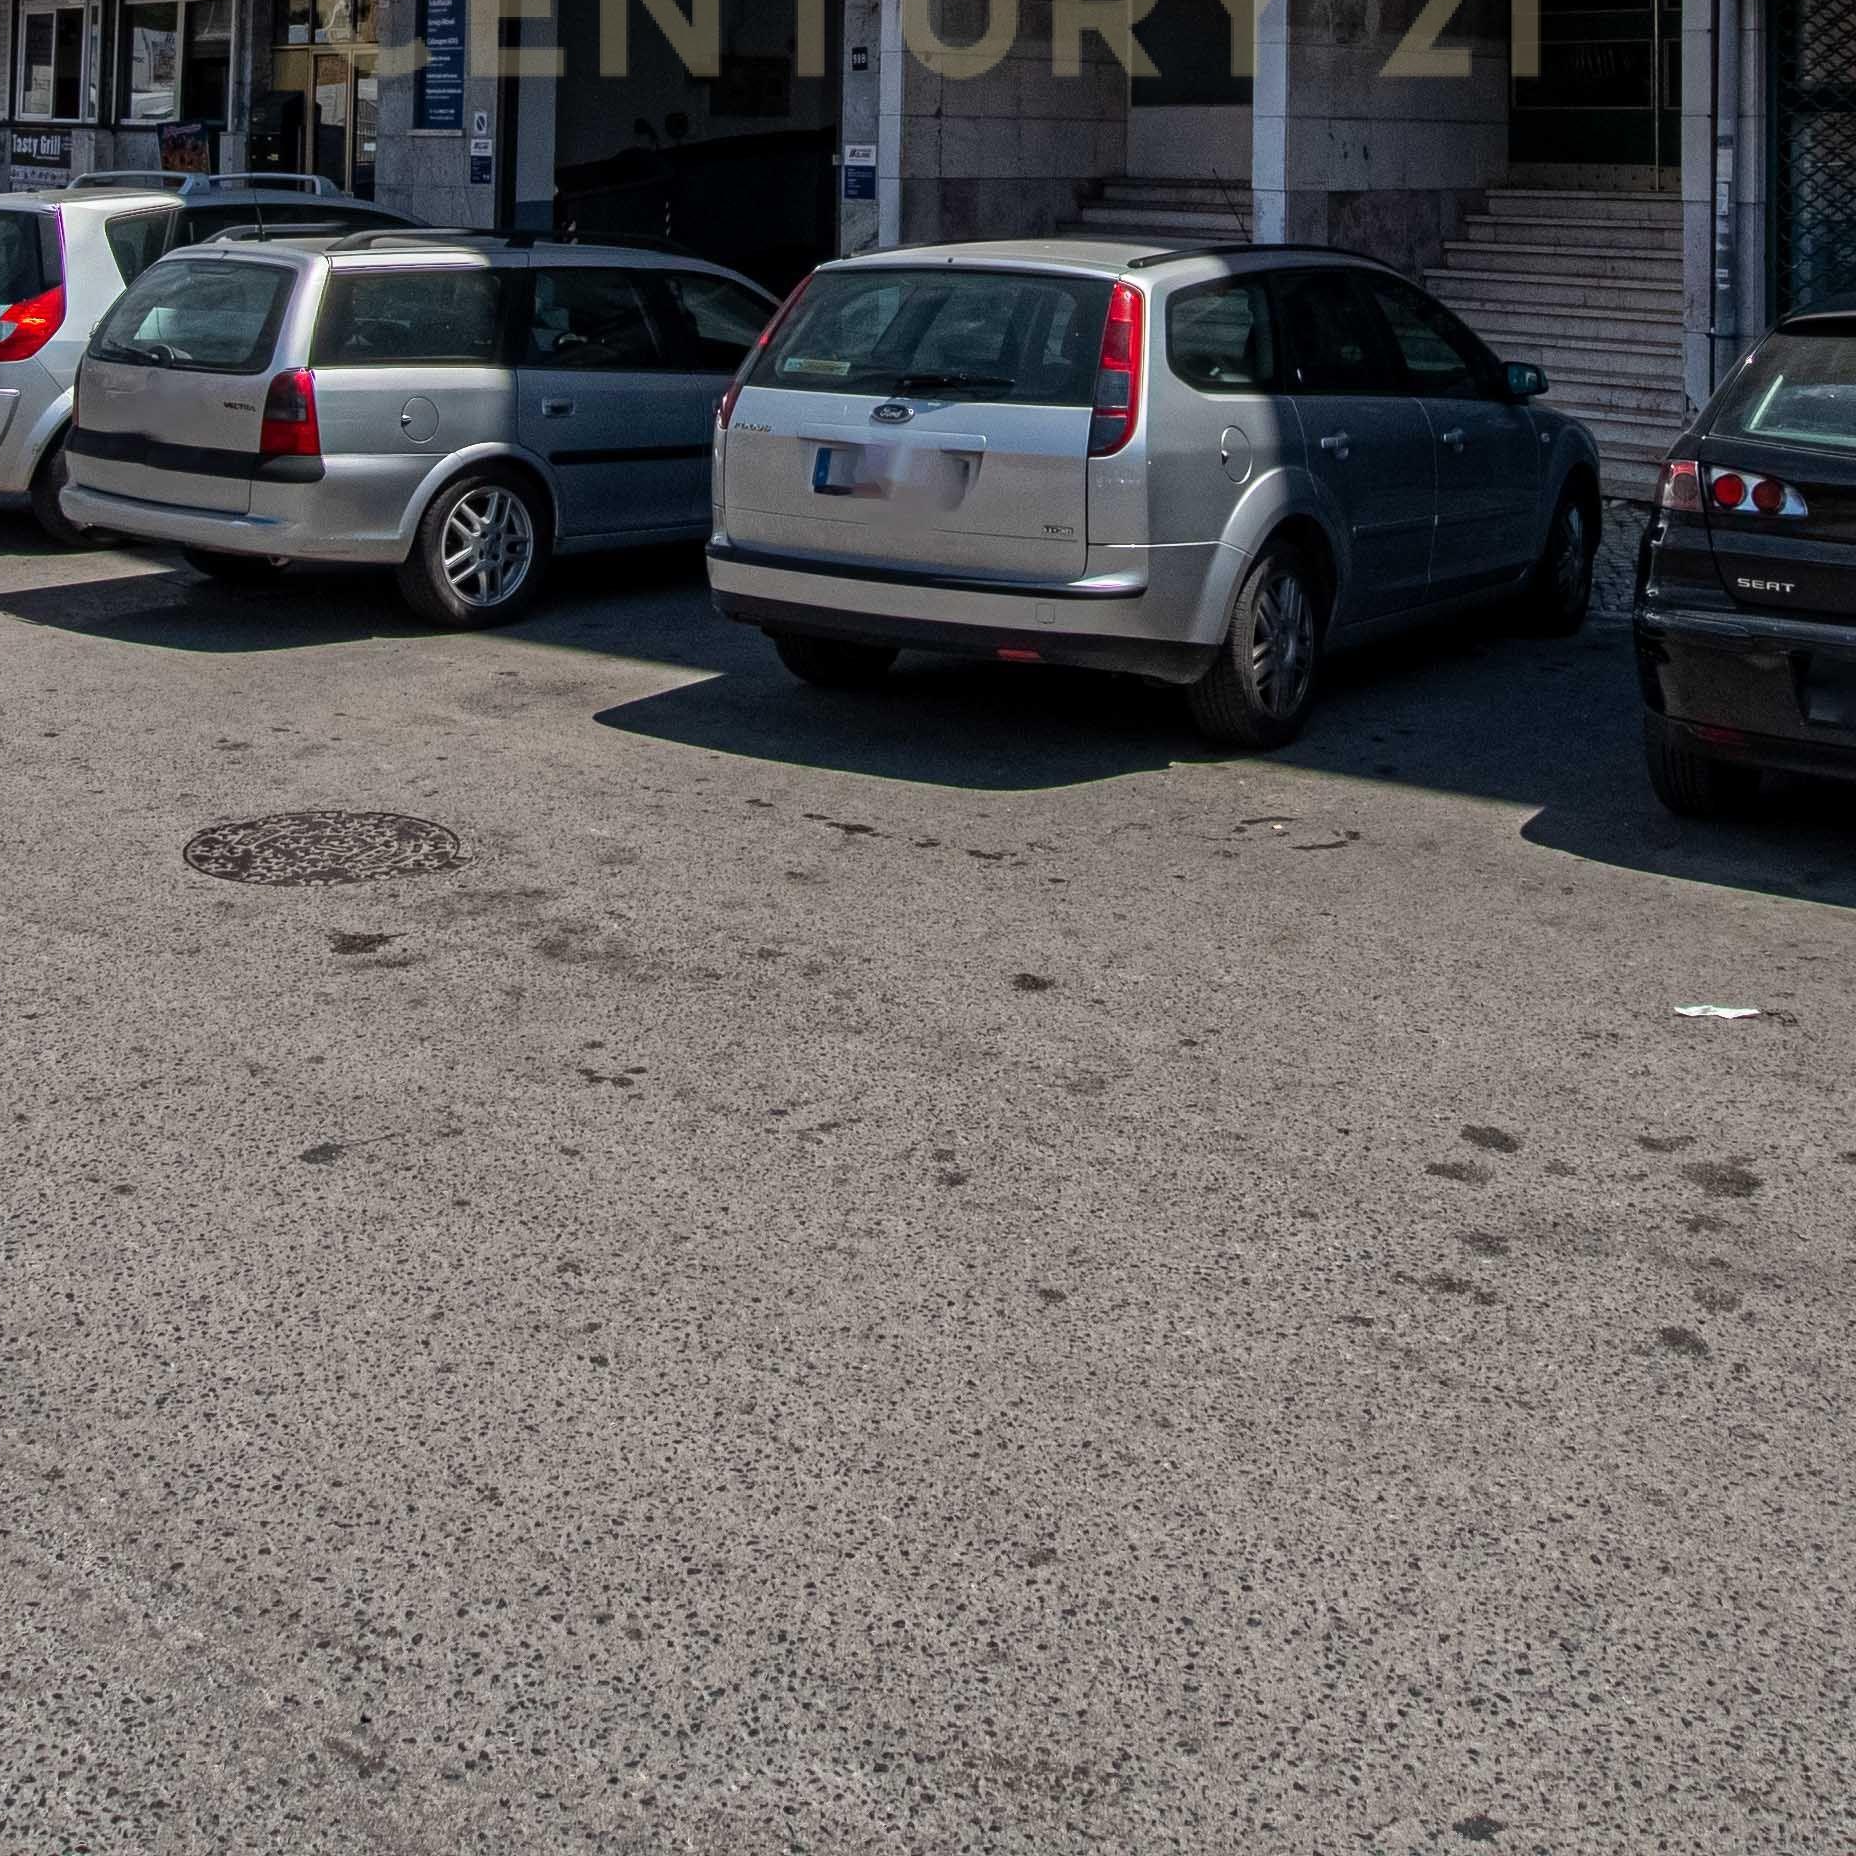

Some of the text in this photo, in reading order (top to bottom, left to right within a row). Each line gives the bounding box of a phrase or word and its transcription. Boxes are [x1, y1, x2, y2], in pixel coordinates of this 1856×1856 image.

[13, 134, 37, 158] Tasty
[40, 135, 61, 156] Grill
[1737, 577, 1795, 593] SEAT
